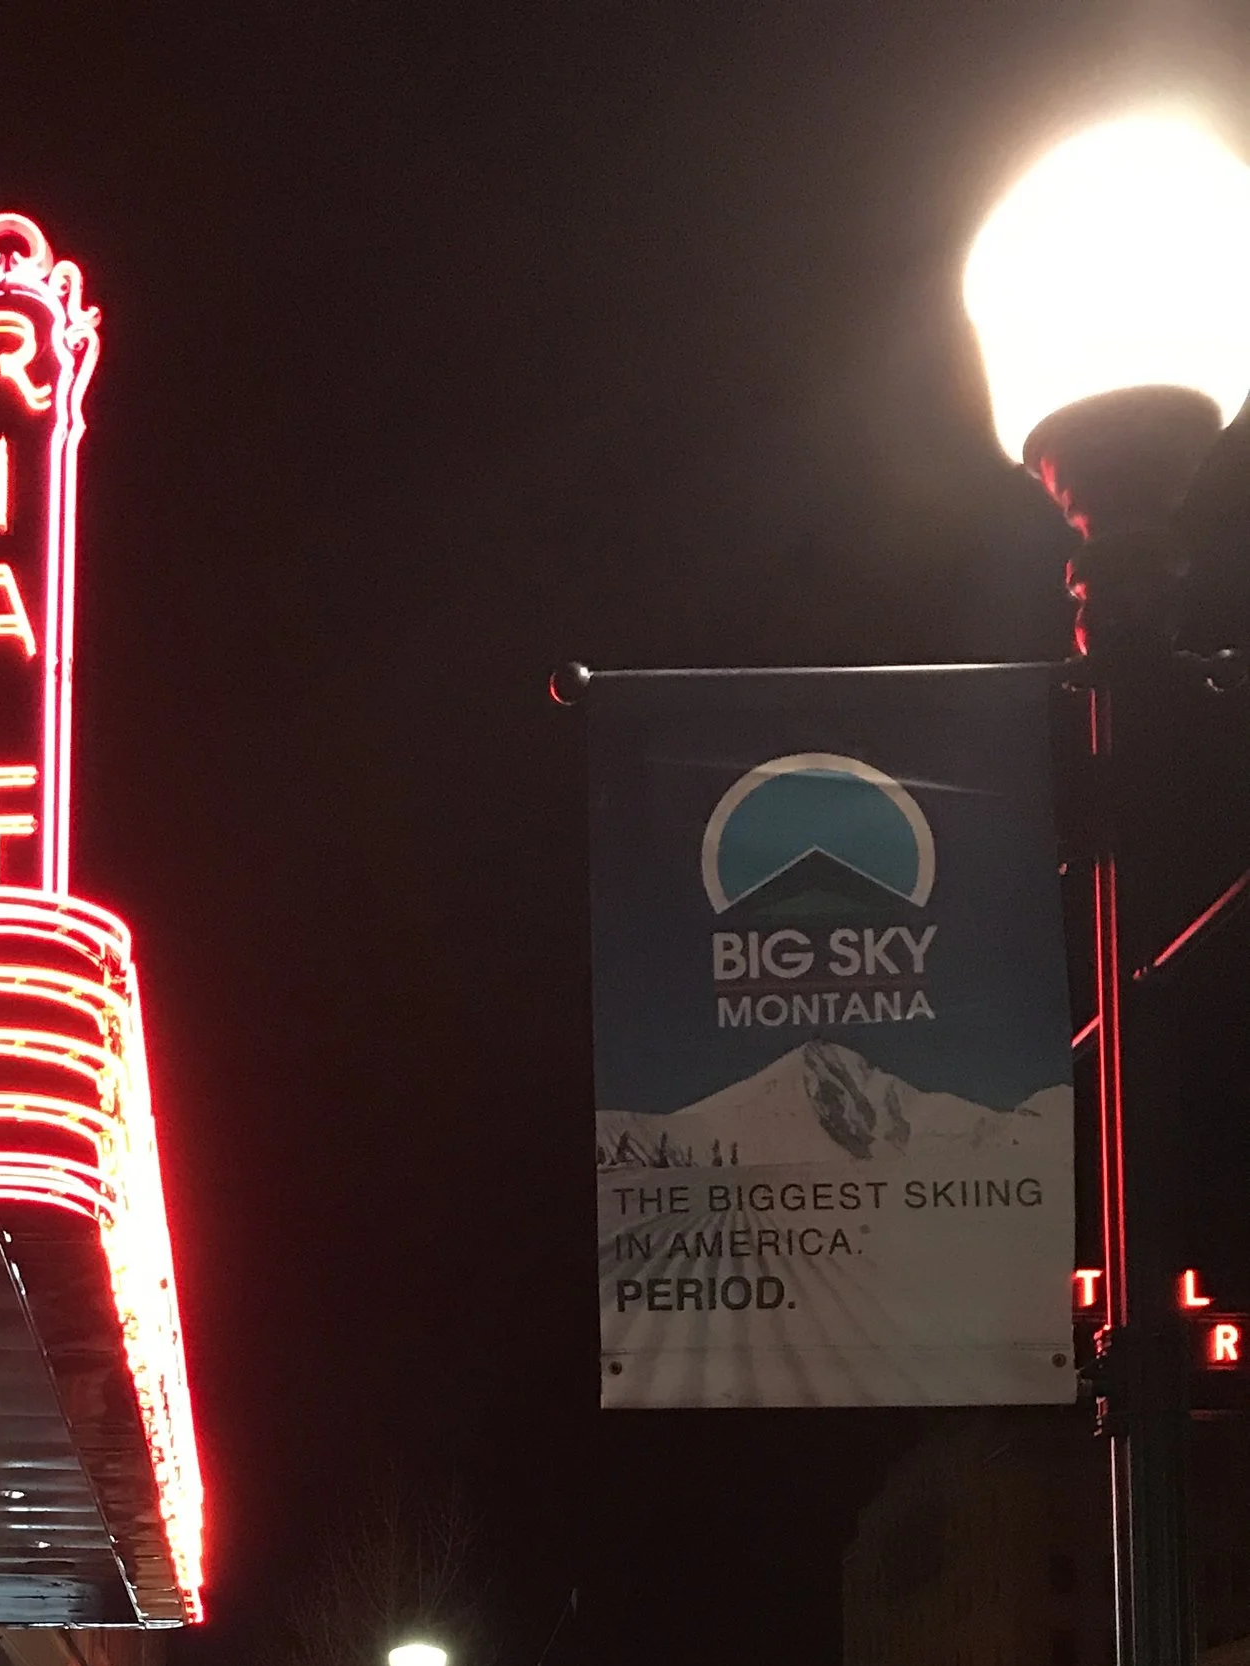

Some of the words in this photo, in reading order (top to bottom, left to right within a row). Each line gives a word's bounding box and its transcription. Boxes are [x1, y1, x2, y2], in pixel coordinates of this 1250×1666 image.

[711, 929, 812, 981] BIG
[829, 925, 937, 977] SKY
[717, 990, 936, 1028] MONTANA
[613, 1187, 692, 1215] THE
[708, 1182, 888, 1213] BIGGEST
[902, 1178, 1044, 1209] SKIING
[614, 1231, 653, 1260] IN
[666, 1227, 863, 1258] AMERICA.
[616, 1275, 797, 1313] PERIOD.
